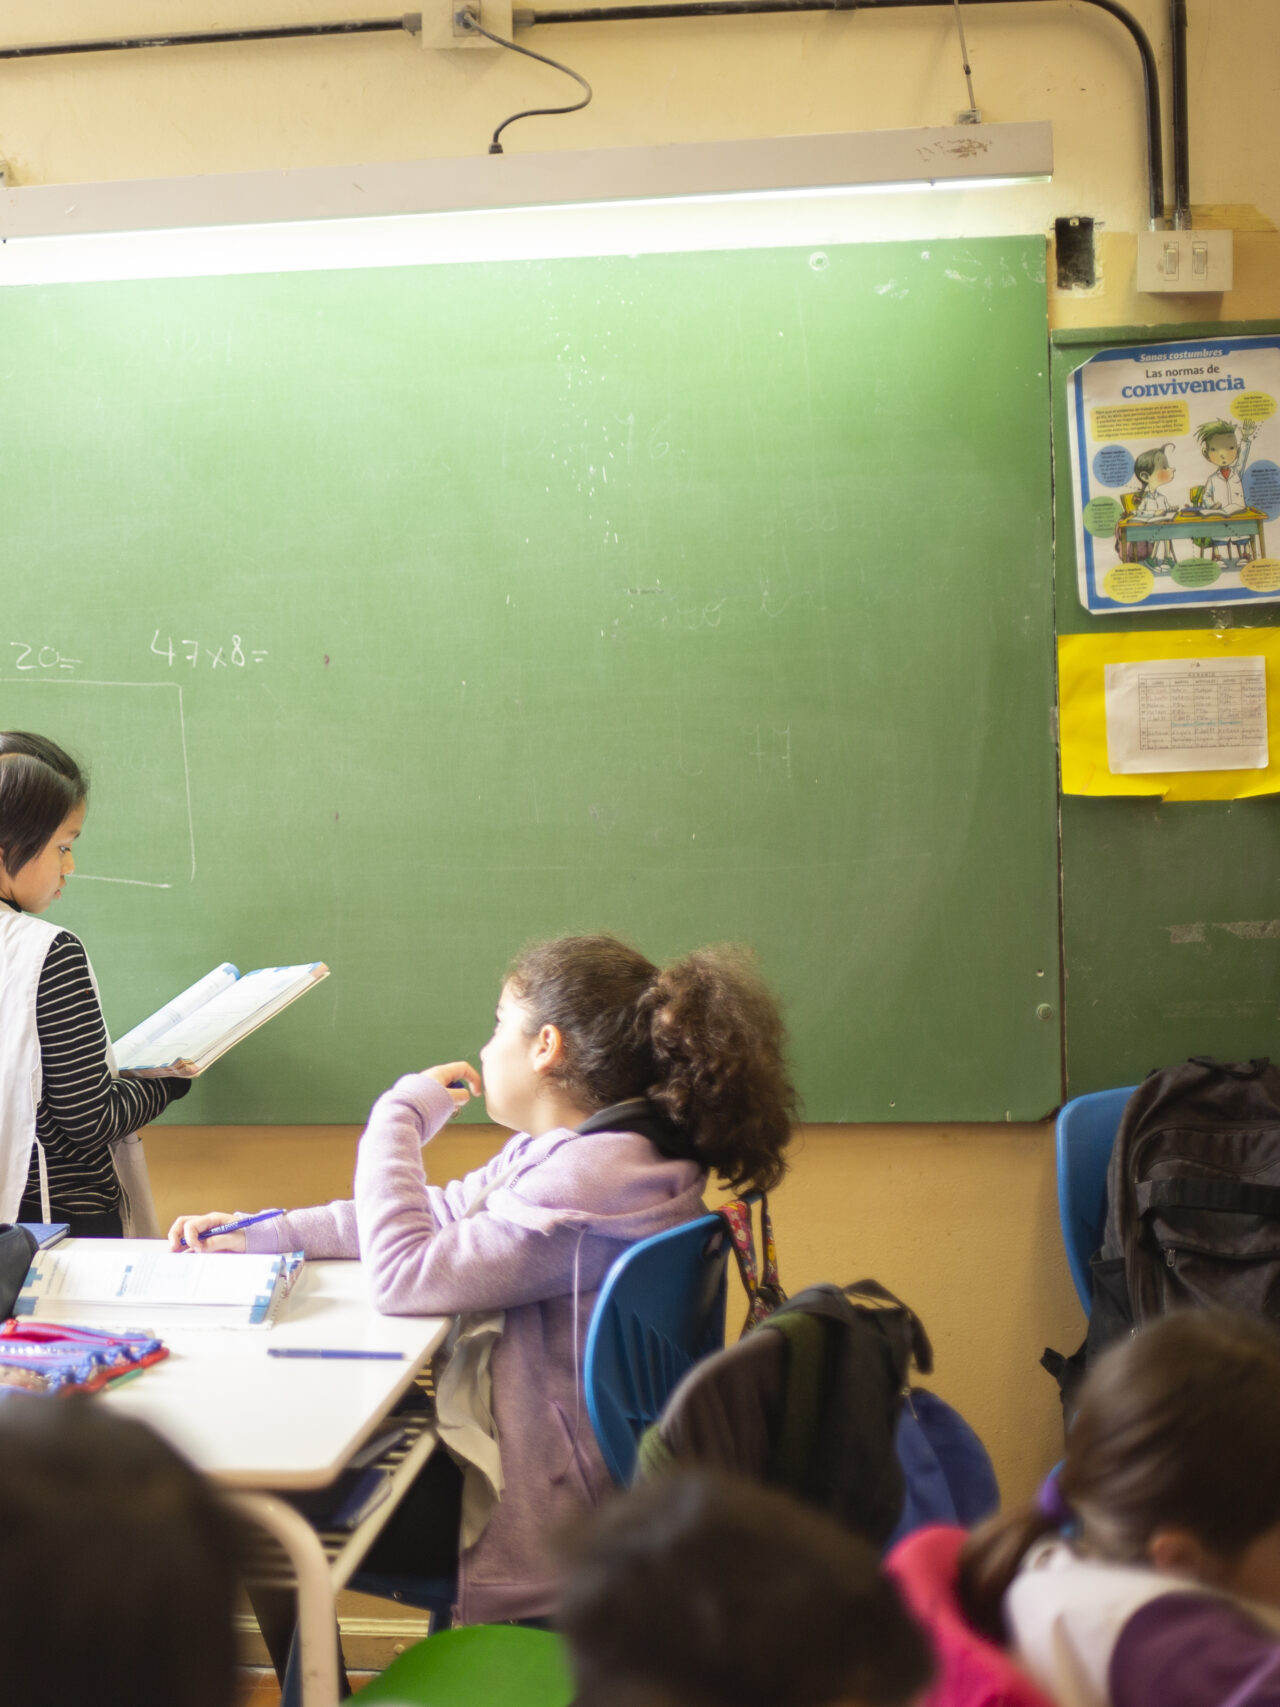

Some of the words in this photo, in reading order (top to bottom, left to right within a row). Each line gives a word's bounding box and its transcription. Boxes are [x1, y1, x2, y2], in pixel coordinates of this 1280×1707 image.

[1140, 352, 1167, 362] Sanas
[1168, 348, 1224, 360] costumbres
[1145, 368, 1163, 379] Las
[1165, 365, 1205, 377] normas
[1207, 363, 1221, 374] de
[1121, 374, 1246, 399] convivencia
